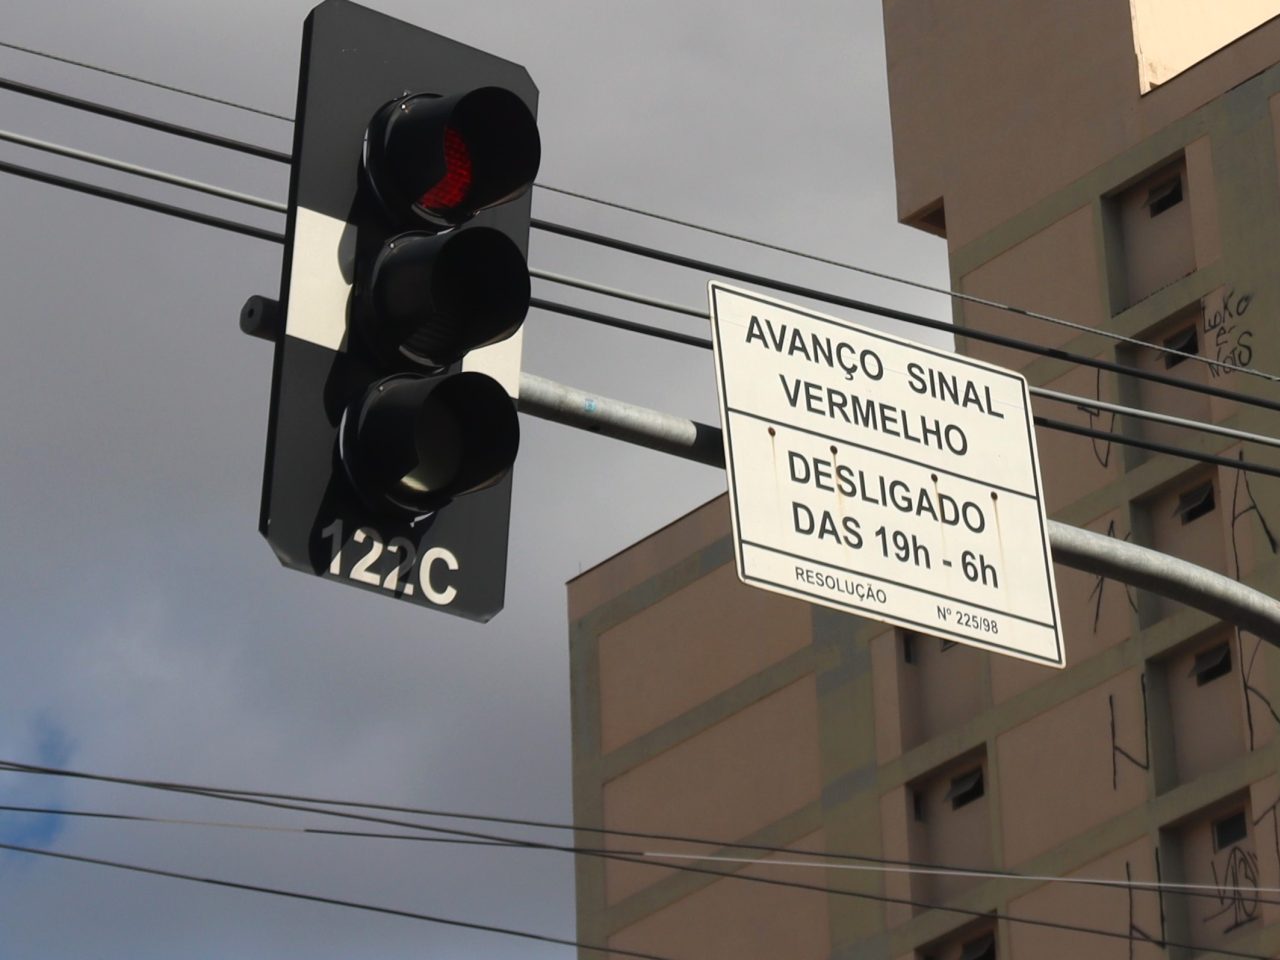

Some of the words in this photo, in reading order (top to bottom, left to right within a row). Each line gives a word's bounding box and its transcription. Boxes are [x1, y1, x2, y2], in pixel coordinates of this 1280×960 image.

[746, 315, 885, 381] AVANÇO
[907, 362, 1005, 419] SINAL
[779, 374, 968, 456] VERMELHO
[788, 450, 986, 534] DESLIGADO
[322, 518, 459, 605] 122C
[792, 501, 863, 550] DAS
[875, 526, 931, 570] 19h
[961, 550, 999, 589] 6h
[795, 565, 888, 604] RESOLUÇÃO
[956, 611, 999, 635] 225/98
